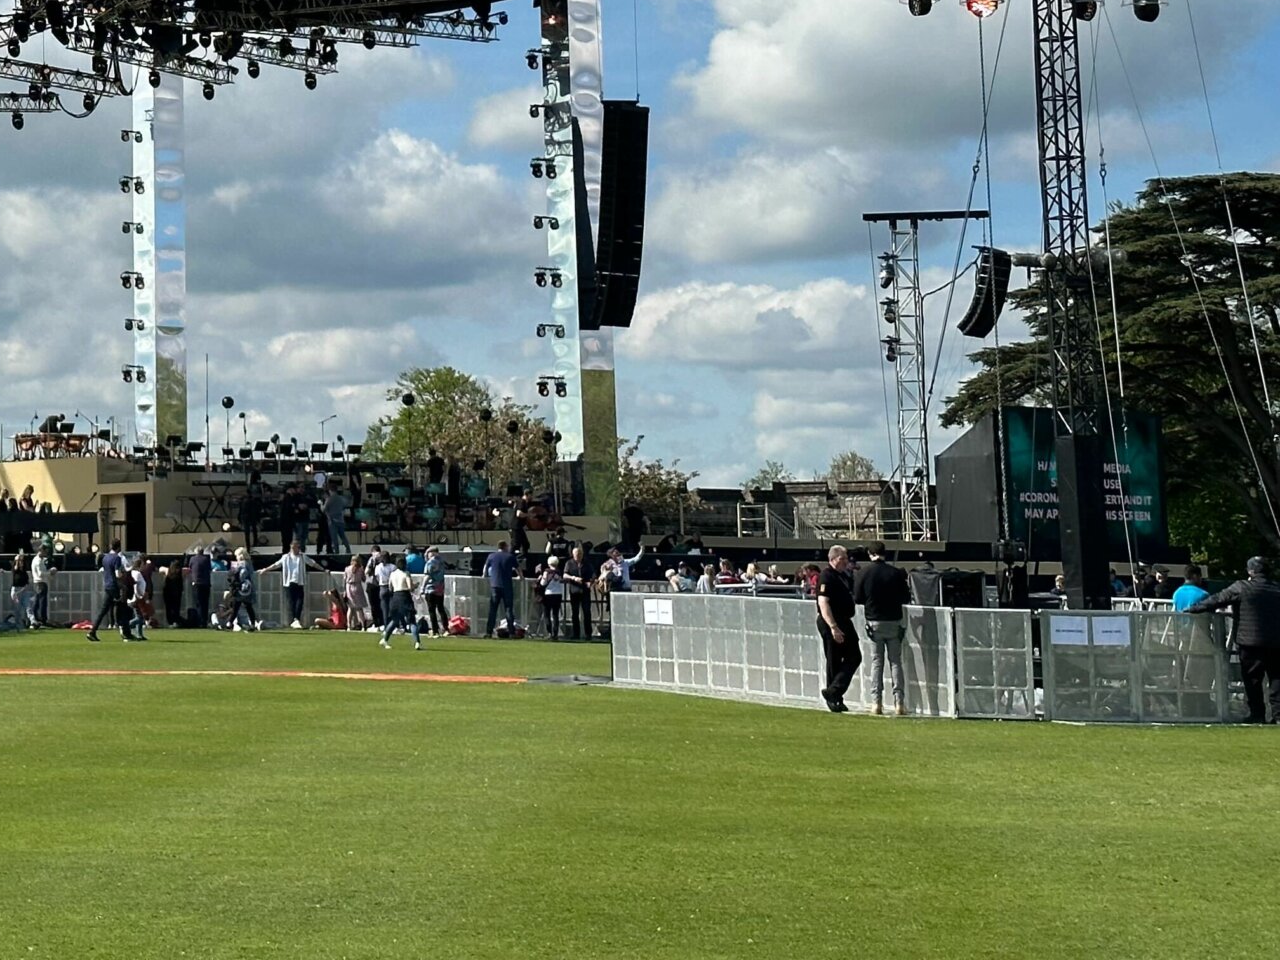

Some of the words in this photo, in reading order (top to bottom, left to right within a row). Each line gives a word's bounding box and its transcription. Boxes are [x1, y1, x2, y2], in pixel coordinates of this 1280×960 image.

[1103, 463, 1132, 474] MEDIA
[1123, 495, 1142, 506] AND
[1024, 508, 1044, 520] MAY
